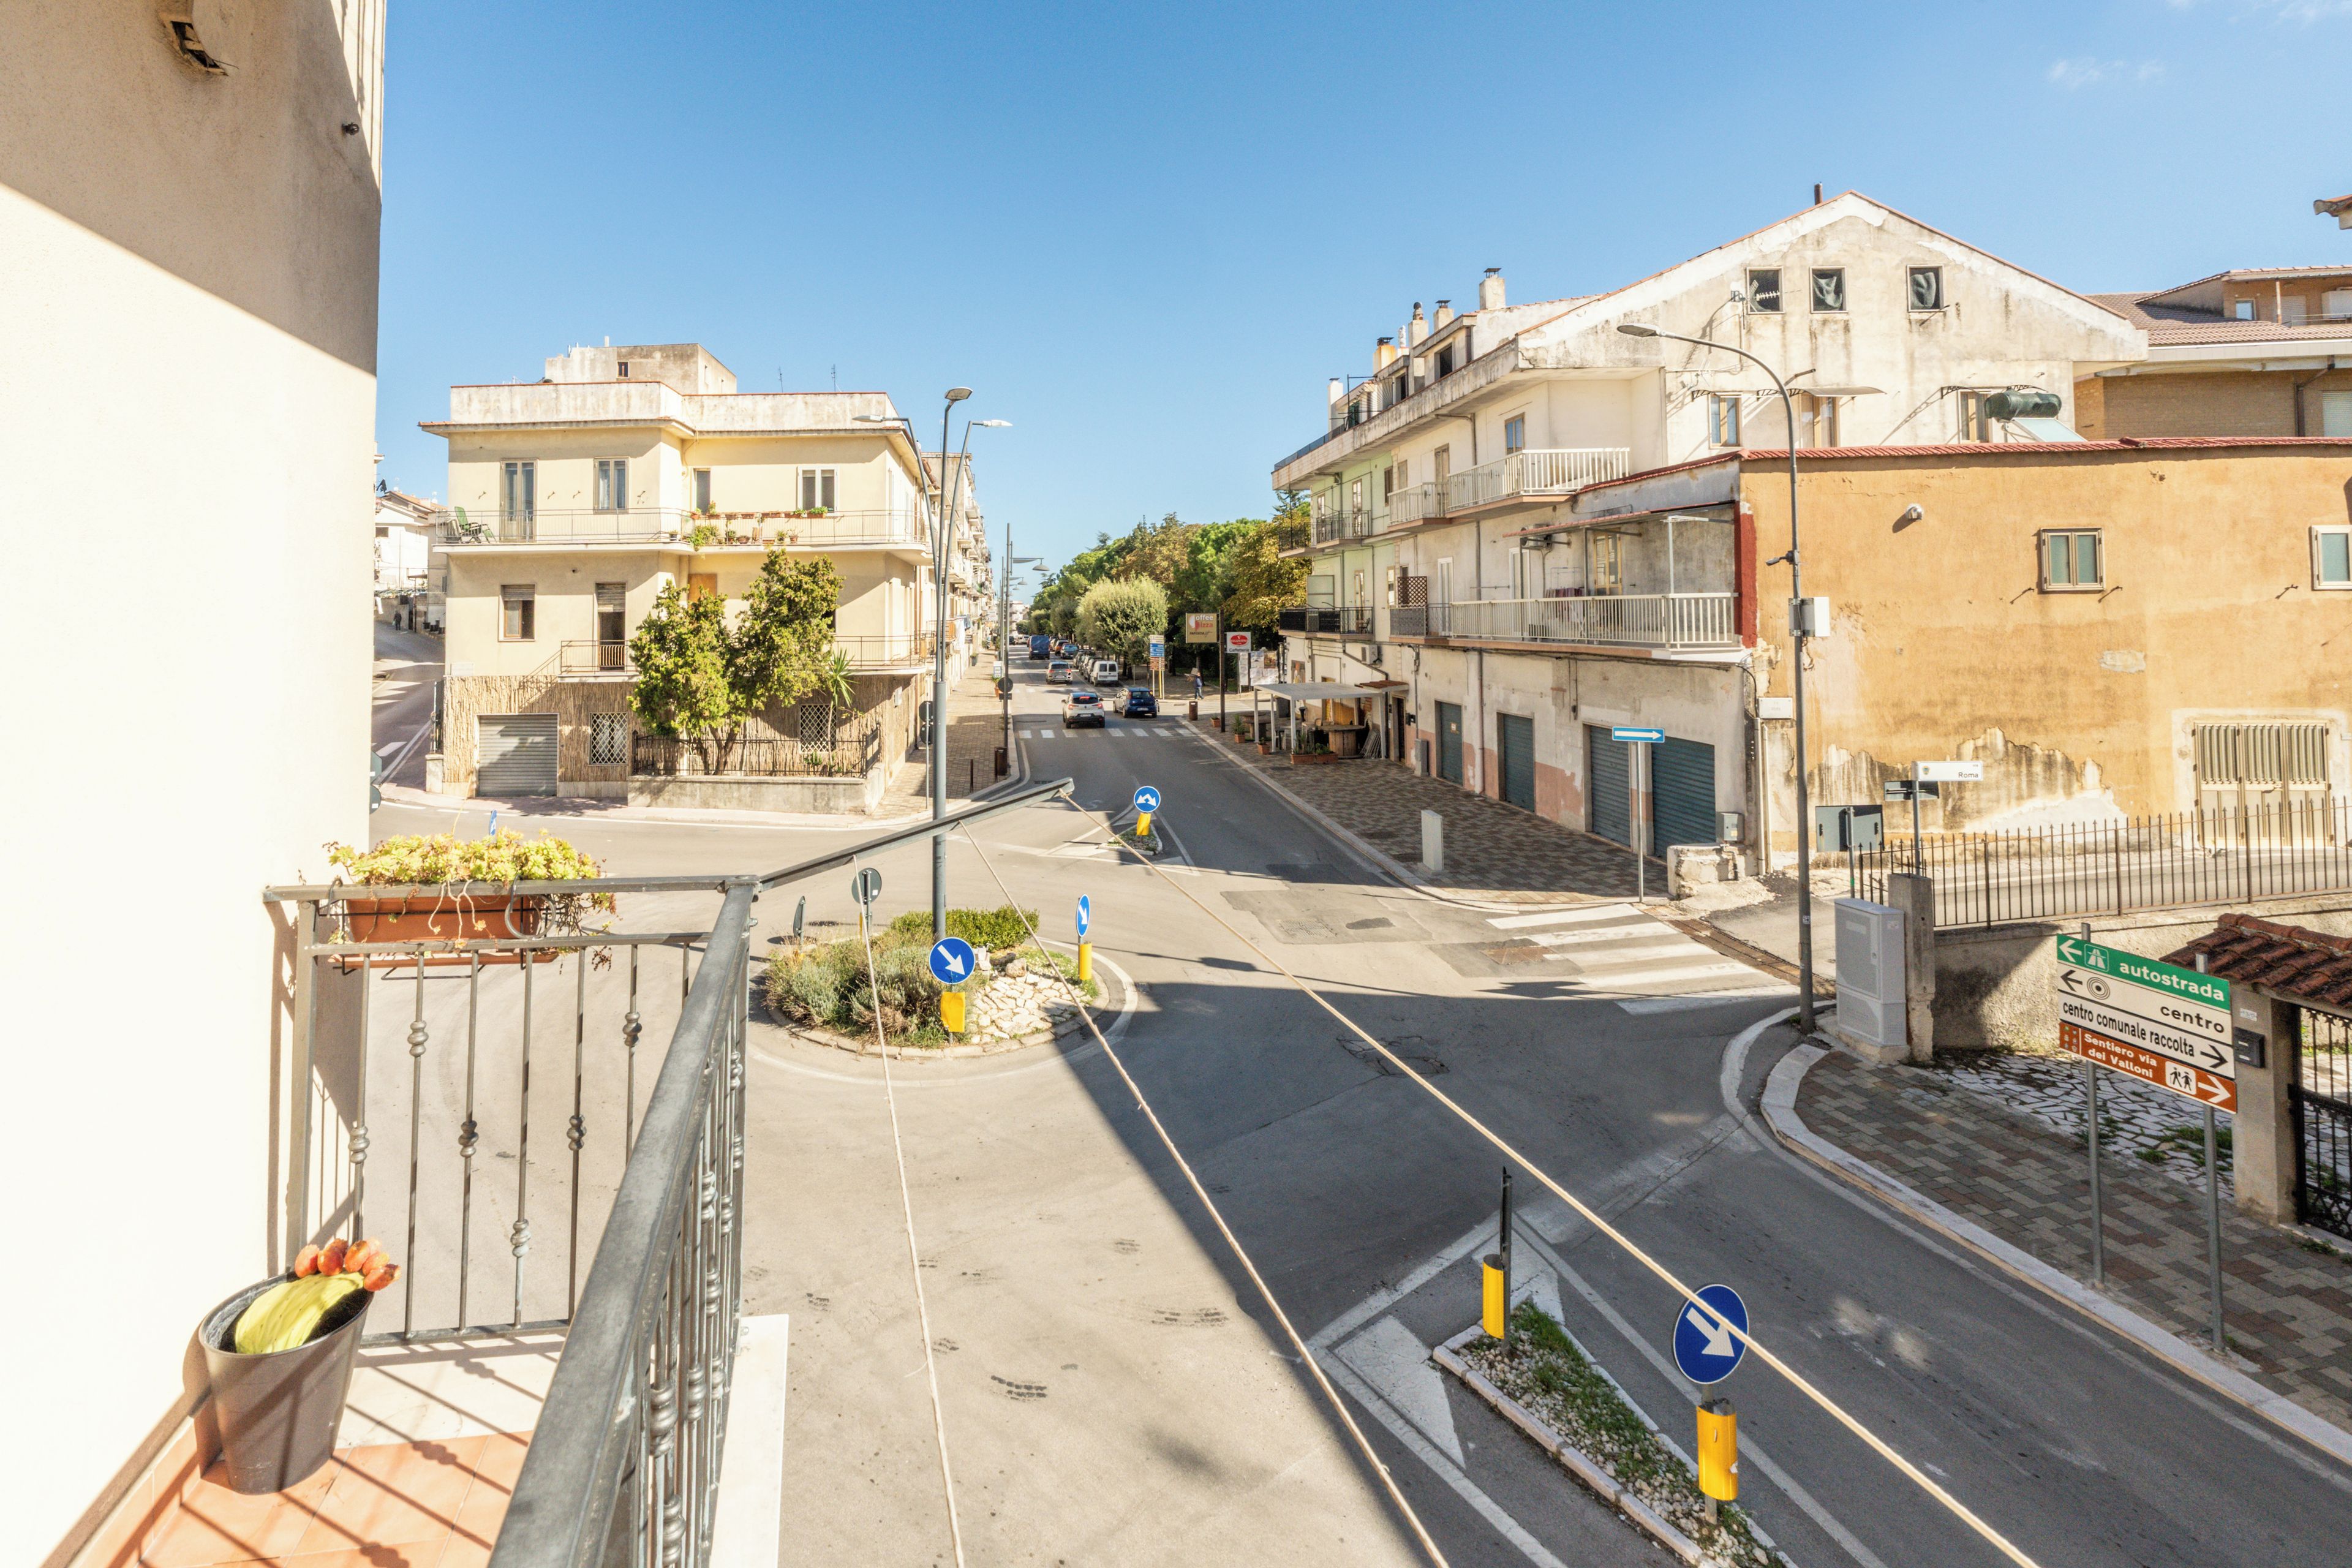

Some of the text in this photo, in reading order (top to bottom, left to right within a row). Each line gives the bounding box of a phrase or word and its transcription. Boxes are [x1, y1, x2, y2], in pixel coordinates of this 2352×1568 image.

[2119, 962, 2225, 1001] autostrada
[2063, 1001, 2195, 1057] centro comunale raccolta
[2160, 1006, 2225, 1033] centro
[2084, 1033, 2157, 1066] Sentiero via
[2088, 1048, 2153, 1078] dei Valloni
